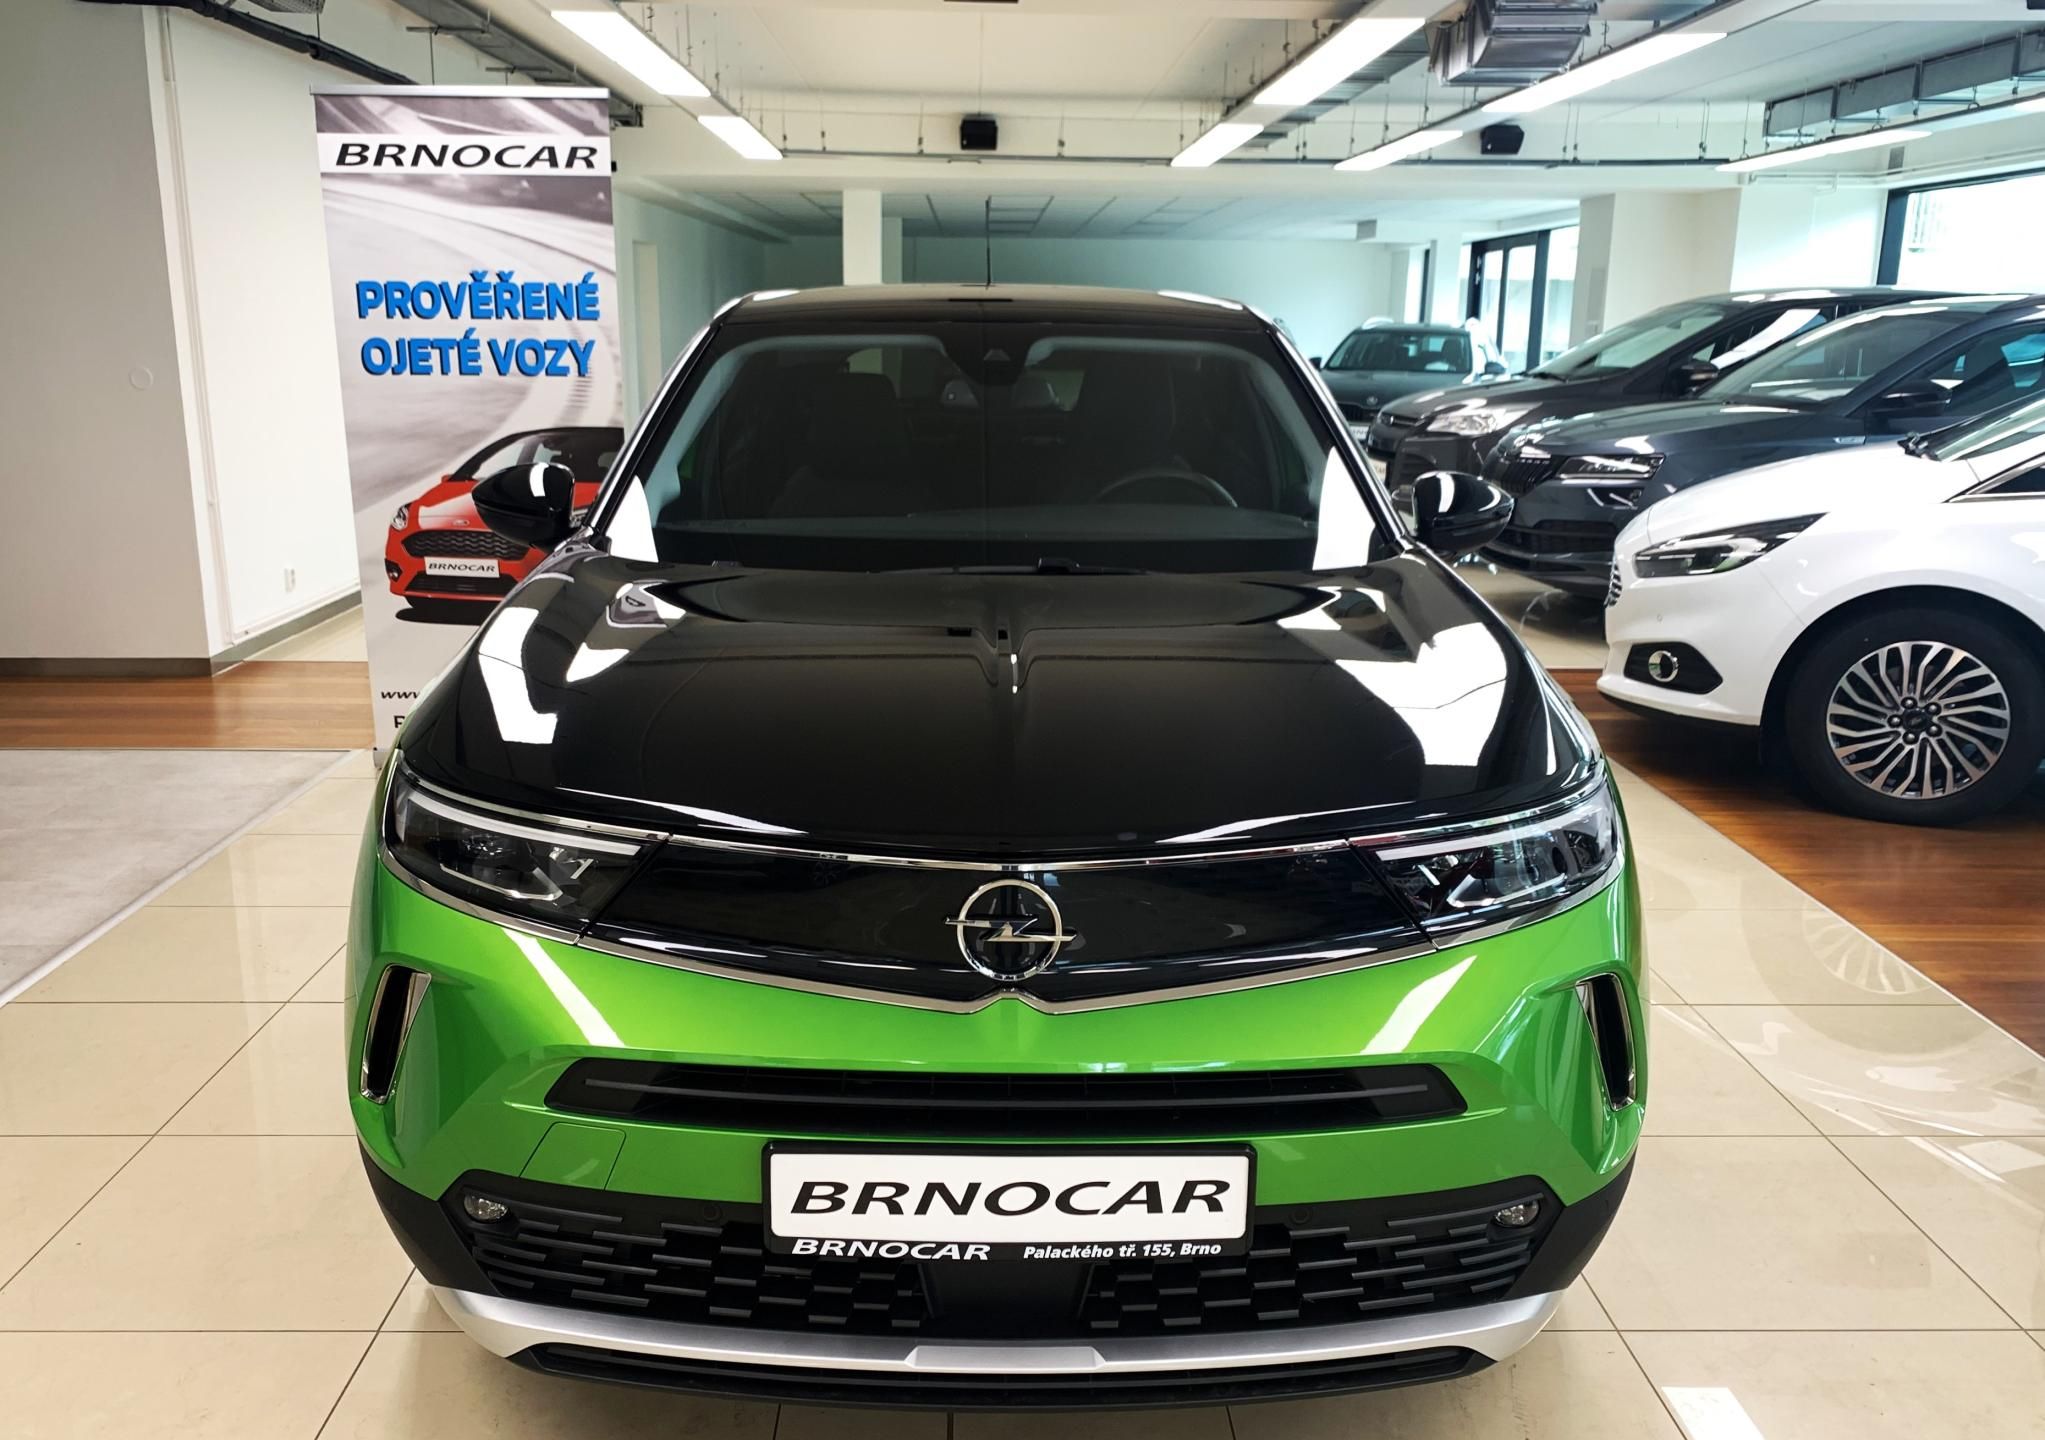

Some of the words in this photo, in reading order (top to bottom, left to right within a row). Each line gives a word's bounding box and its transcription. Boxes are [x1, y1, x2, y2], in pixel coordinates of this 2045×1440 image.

[336, 143, 597, 169] BRNOCAR
[356, 270, 601, 320] PROVĚŘENÉ
[361, 327, 482, 376] OJETÉ
[487, 339, 596, 377] VOZY
[428, 562, 496, 573] BRNOCAR
[791, 1180, 1231, 1217] BRNOCAR
[792, 1239, 991, 1261] BRNOCAR
[1023, 1244, 1114, 1259] Palackého
[1118, 1245, 1137, 1258] tř.
[1143, 1243, 1176, 1258] 155,
[1179, 1243, 1221, 1255] Brno
